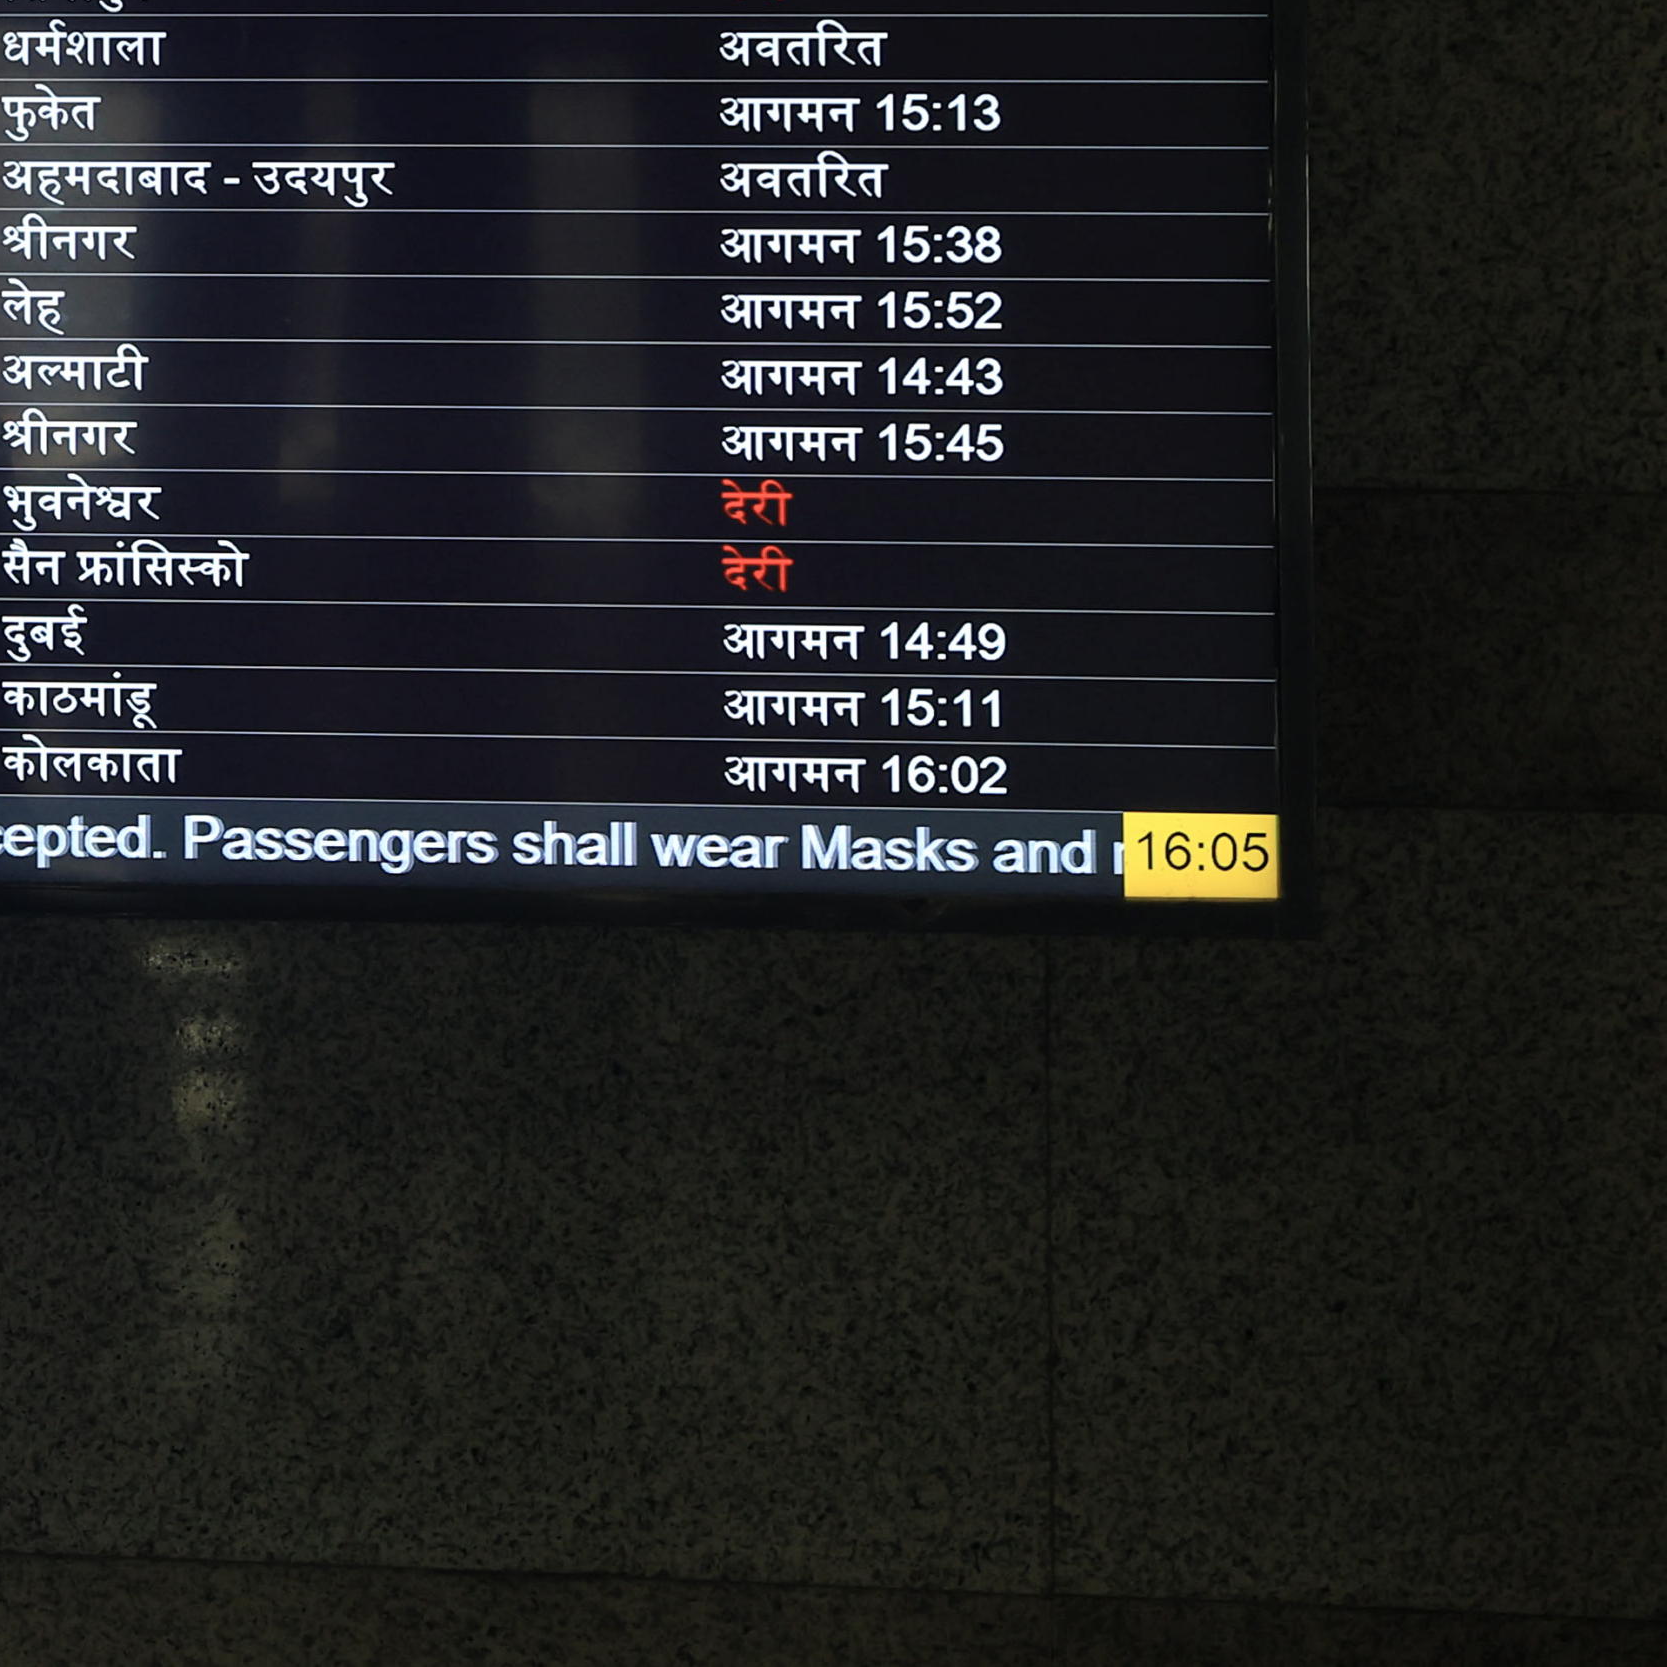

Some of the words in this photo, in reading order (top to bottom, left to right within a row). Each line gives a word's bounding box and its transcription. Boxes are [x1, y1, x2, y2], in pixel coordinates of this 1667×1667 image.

[2, 18, 167, 66] धर्मशाला
[719, 19, 889, 67] अवतरित
[0, 83, 102, 142] फुकेत
[719, 97, 861, 133] आगमन
[876, 93, 1001, 132] 15:13
[2, 160, 212, 206] अहमदाबाद
[251, 161, 396, 208] उदयपुर
[719, 150, 890, 199] अवतरित
[2, 213, 138, 261] श्रीनगर
[720, 228, 862, 264] आगमन
[877, 225, 1002, 264] 15:38
[1, 278, 66, 336] लेह
[720, 294, 863, 330] आगमन
[877, 290, 1003, 330] 15:52
[2, 344, 150, 391] अल्माटी
[721, 360, 863, 396] आगमन
[878, 356, 1004, 396] 14:43
[2, 408, 138, 456] श्रीनगर
[721, 426, 864, 462] आगमन
[878, 423, 1004, 462] 15:45
[2, 473, 162, 532] भुवनेश्वर
[721, 479, 793, 526] देरी
[1, 538, 67, 586] सैन
[75, 539, 250, 588] फ्रांसिस्को
[721, 545, 794, 592] देरी
[1, 604, 88, 662] दुबई
[723, 623, 866, 661] आगमन
[880, 621, 1006, 661] 14:49
[1, 671, 158, 729] काठमांडू
[723, 690, 866, 727] आगमन
[881, 687, 1000, 728] 15:11
[1, 733, 183, 784] कोलकाता
[724, 756, 867, 794] आगमन
[882, 754, 1008, 795] 16:02
[184, 814, 500, 875] Passengers
[511, 820, 638, 867] shall
[650, 833, 790, 869] wear
[801, 823, 980, 872] Masks
[992, 828, 1097, 875] and
[1138, 831, 1269, 872] 16:05
